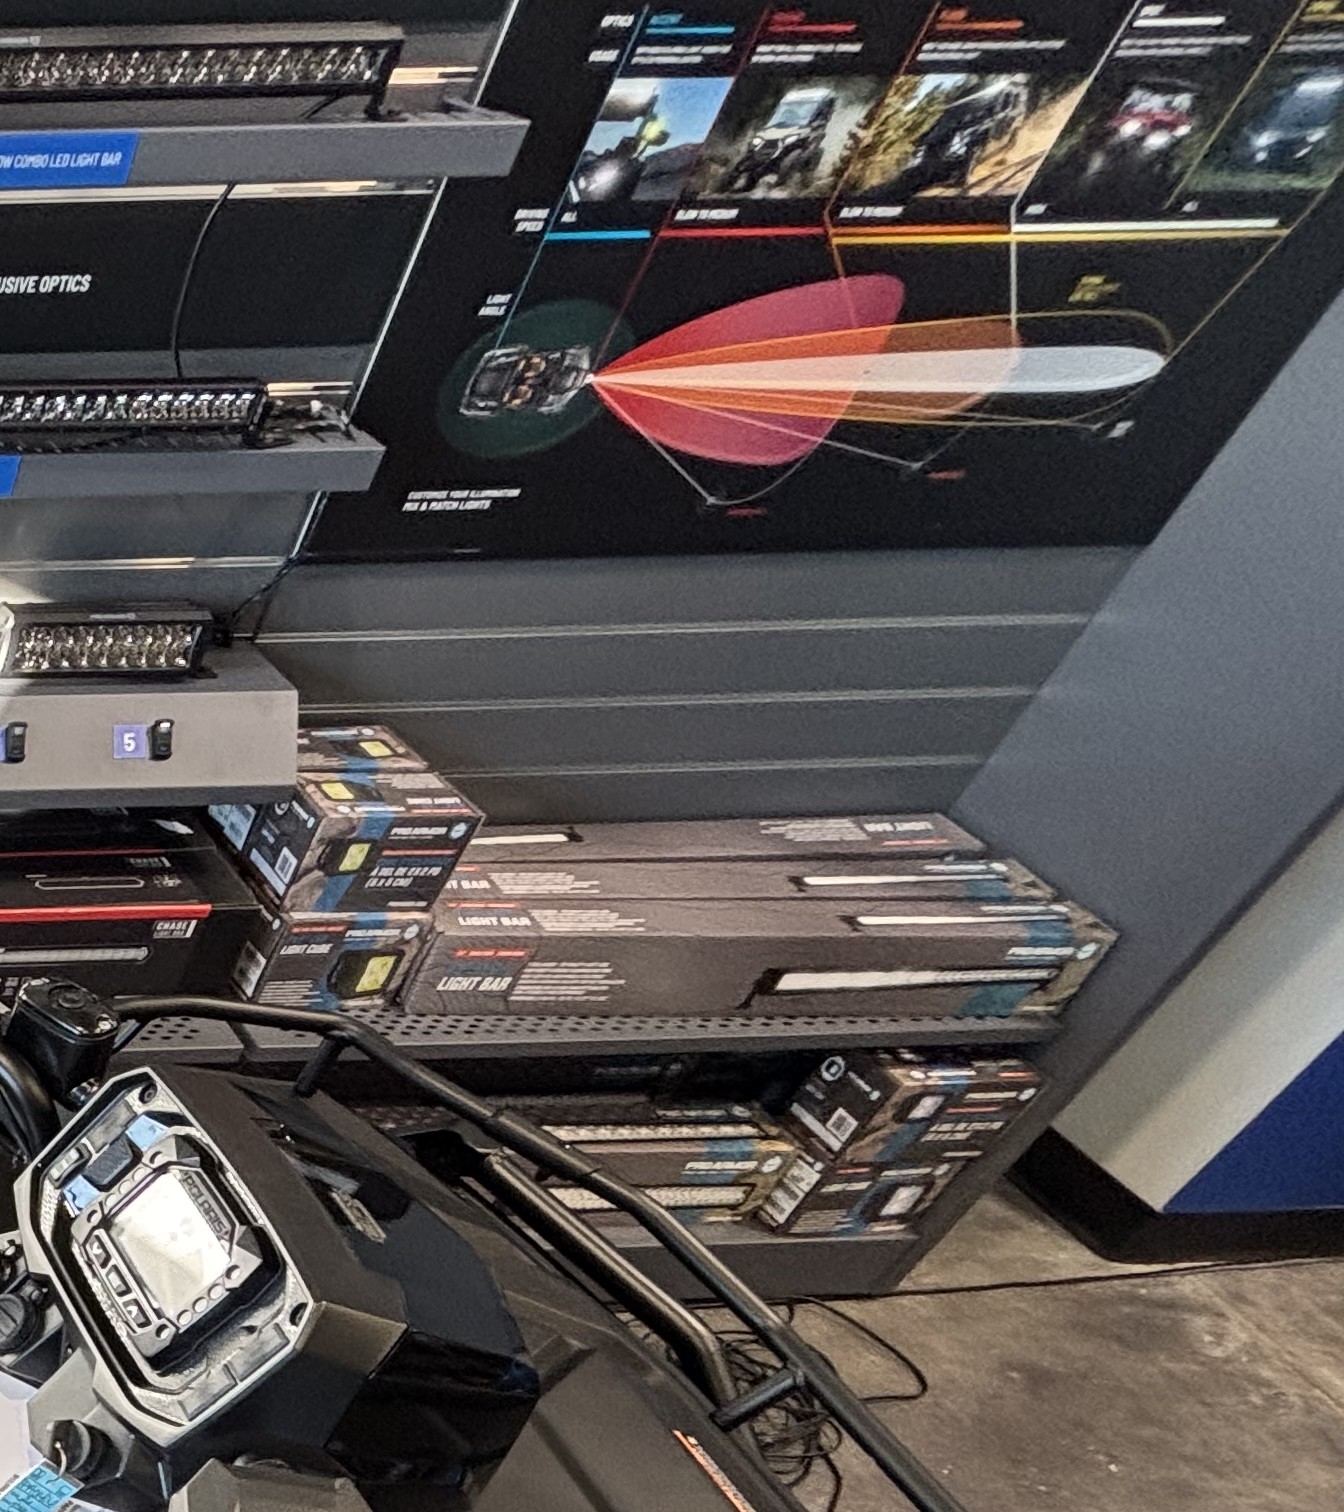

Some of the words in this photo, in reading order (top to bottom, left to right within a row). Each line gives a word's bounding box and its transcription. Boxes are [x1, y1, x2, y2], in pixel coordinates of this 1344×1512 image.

[14, 154, 48, 169] COMBO
[49, 153, 69, 168] LED
[70, 152, 100, 167] LIGHT
[100, 152, 123, 166] BAR
[39, 274, 92, 295] OPTICS
[123, 732, 136, 752] 5
[155, 921, 189, 932] CHASE
[458, 917, 499, 926] LIGHT
[500, 917, 532, 926] BAR
[436, 976, 482, 991] LIGHT
[479, 976, 513, 991] BAR
[183, 1173, 228, 1235] POLARIS
